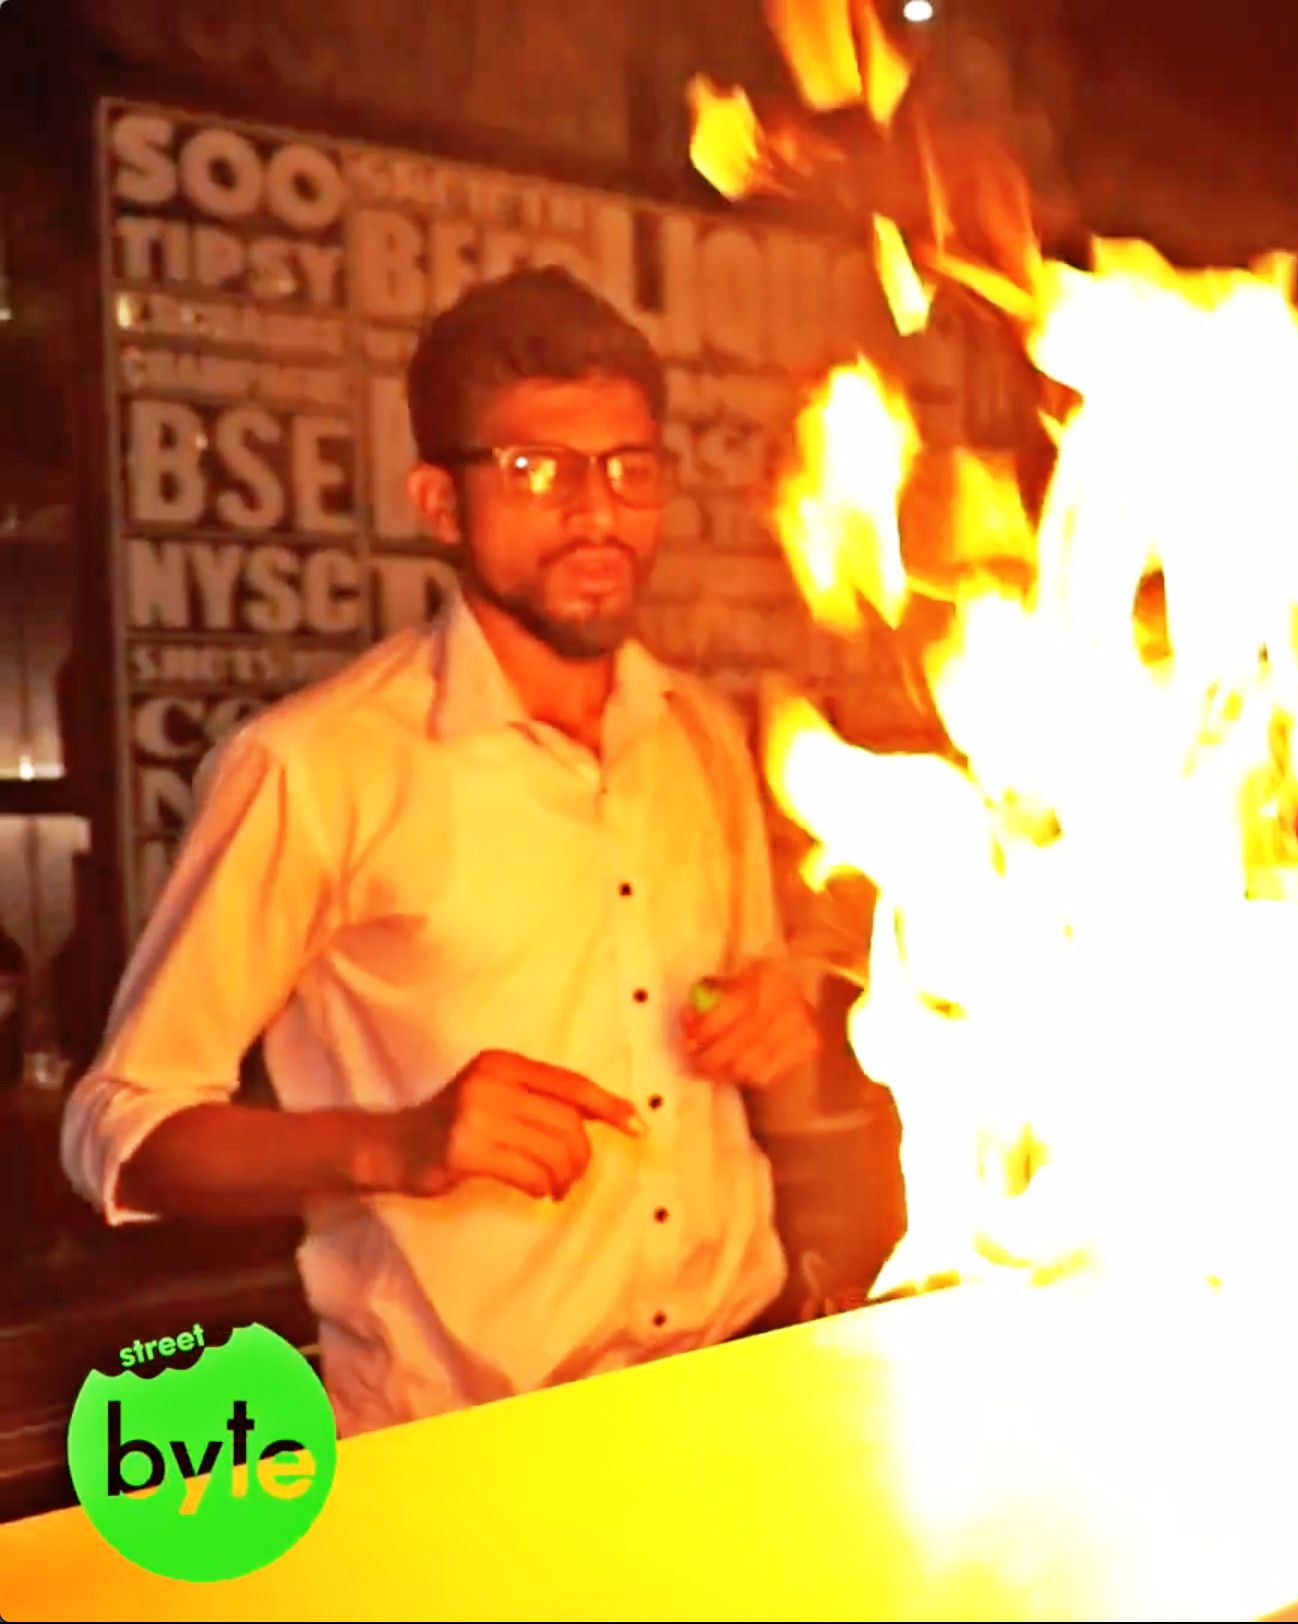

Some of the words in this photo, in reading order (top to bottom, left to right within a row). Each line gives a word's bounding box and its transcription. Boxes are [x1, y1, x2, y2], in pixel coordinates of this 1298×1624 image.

[113, 114, 341, 230] SOO
[114, 216, 343, 304] TIPSY
[131, 399, 357, 529] BSE
